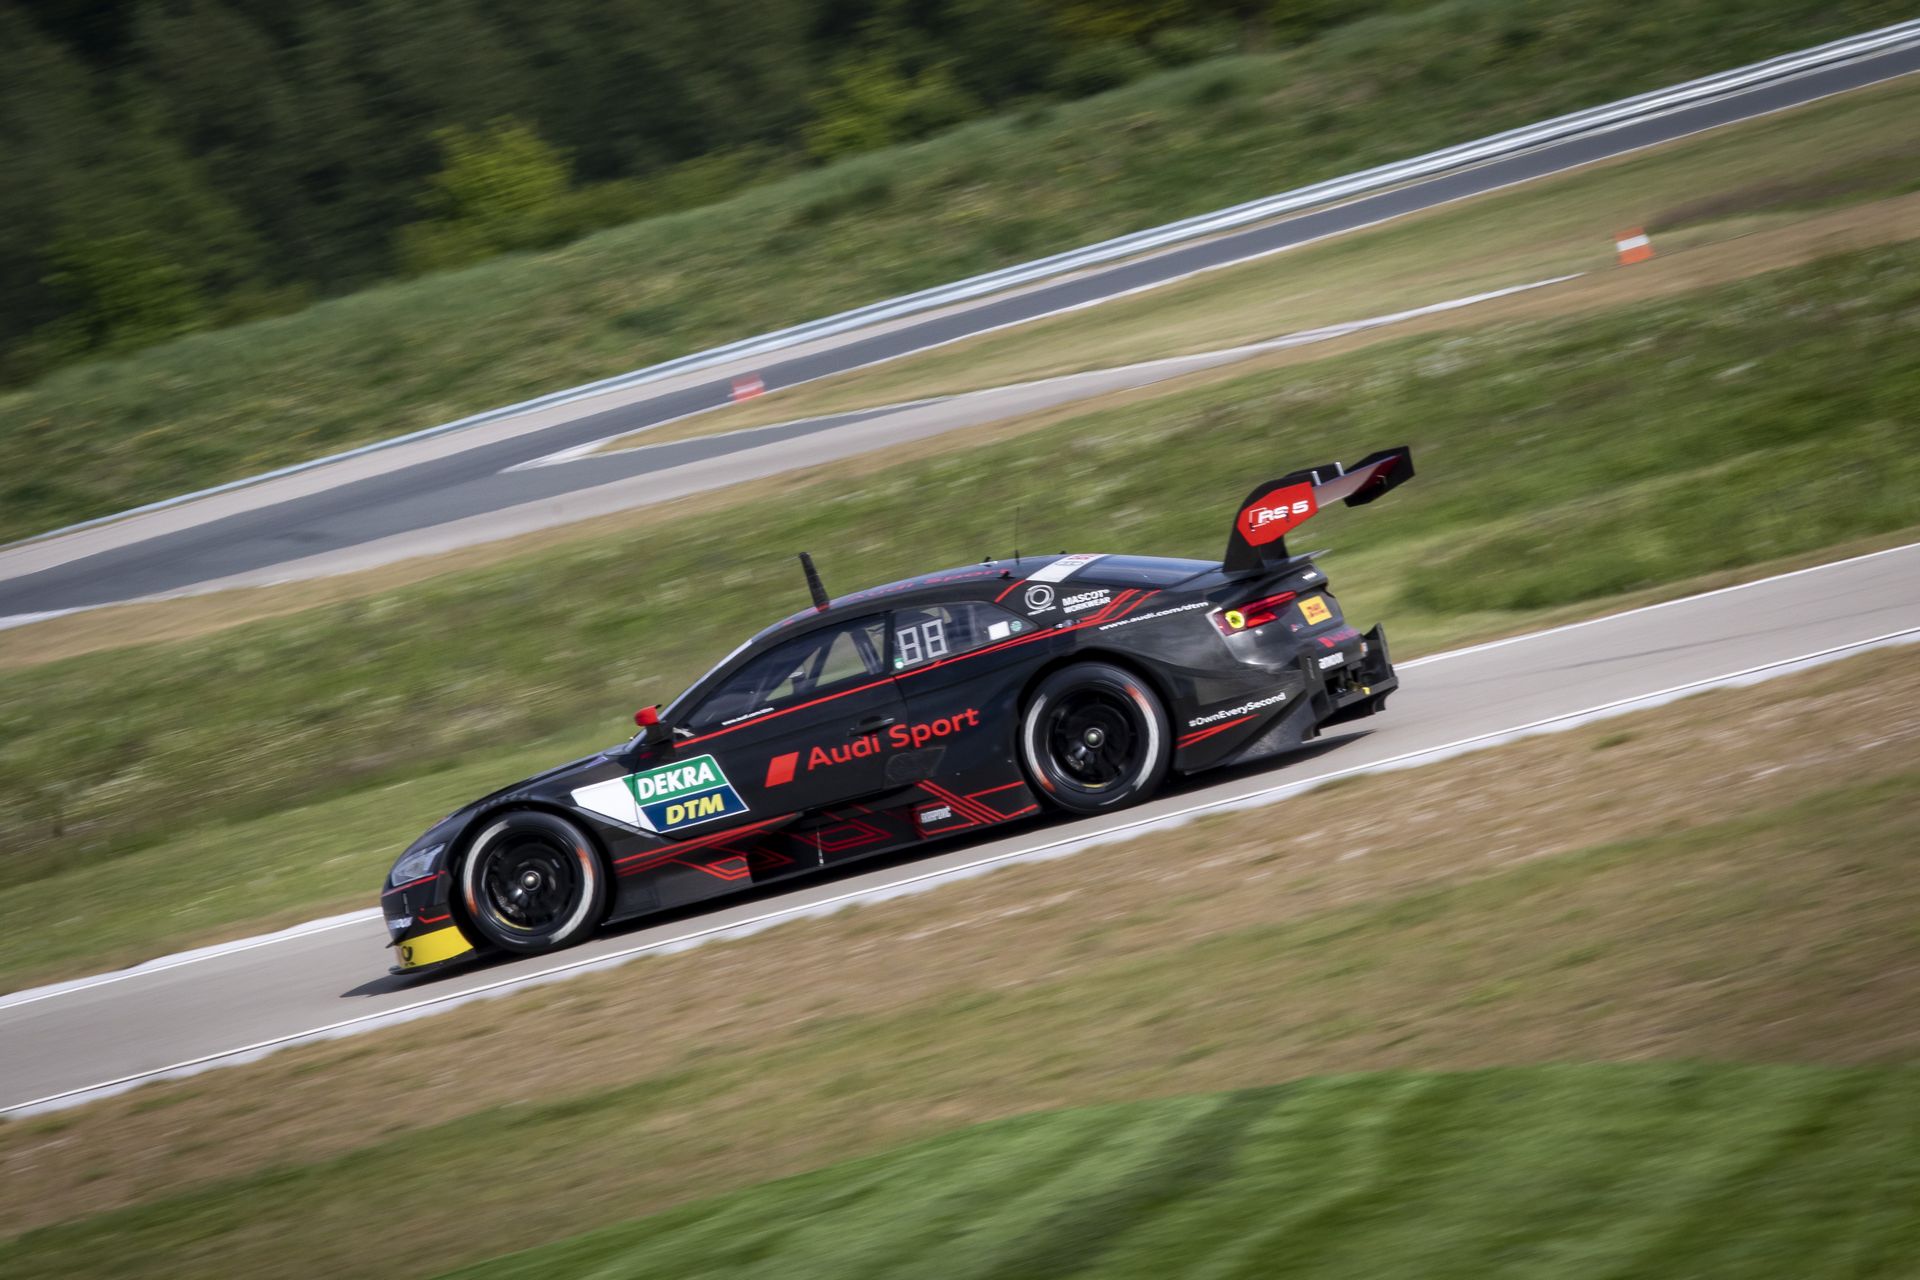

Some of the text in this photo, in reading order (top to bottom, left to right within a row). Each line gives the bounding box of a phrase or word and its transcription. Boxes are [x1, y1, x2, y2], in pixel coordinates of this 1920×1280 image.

[1257, 500, 1309, 524] RS 5
[1188, 692, 1286, 727] #OwnEverySecond
[807, 708, 980, 771] Audi Sport
[637, 762, 716, 800] DEKRA
[666, 793, 725, 825] DTM
